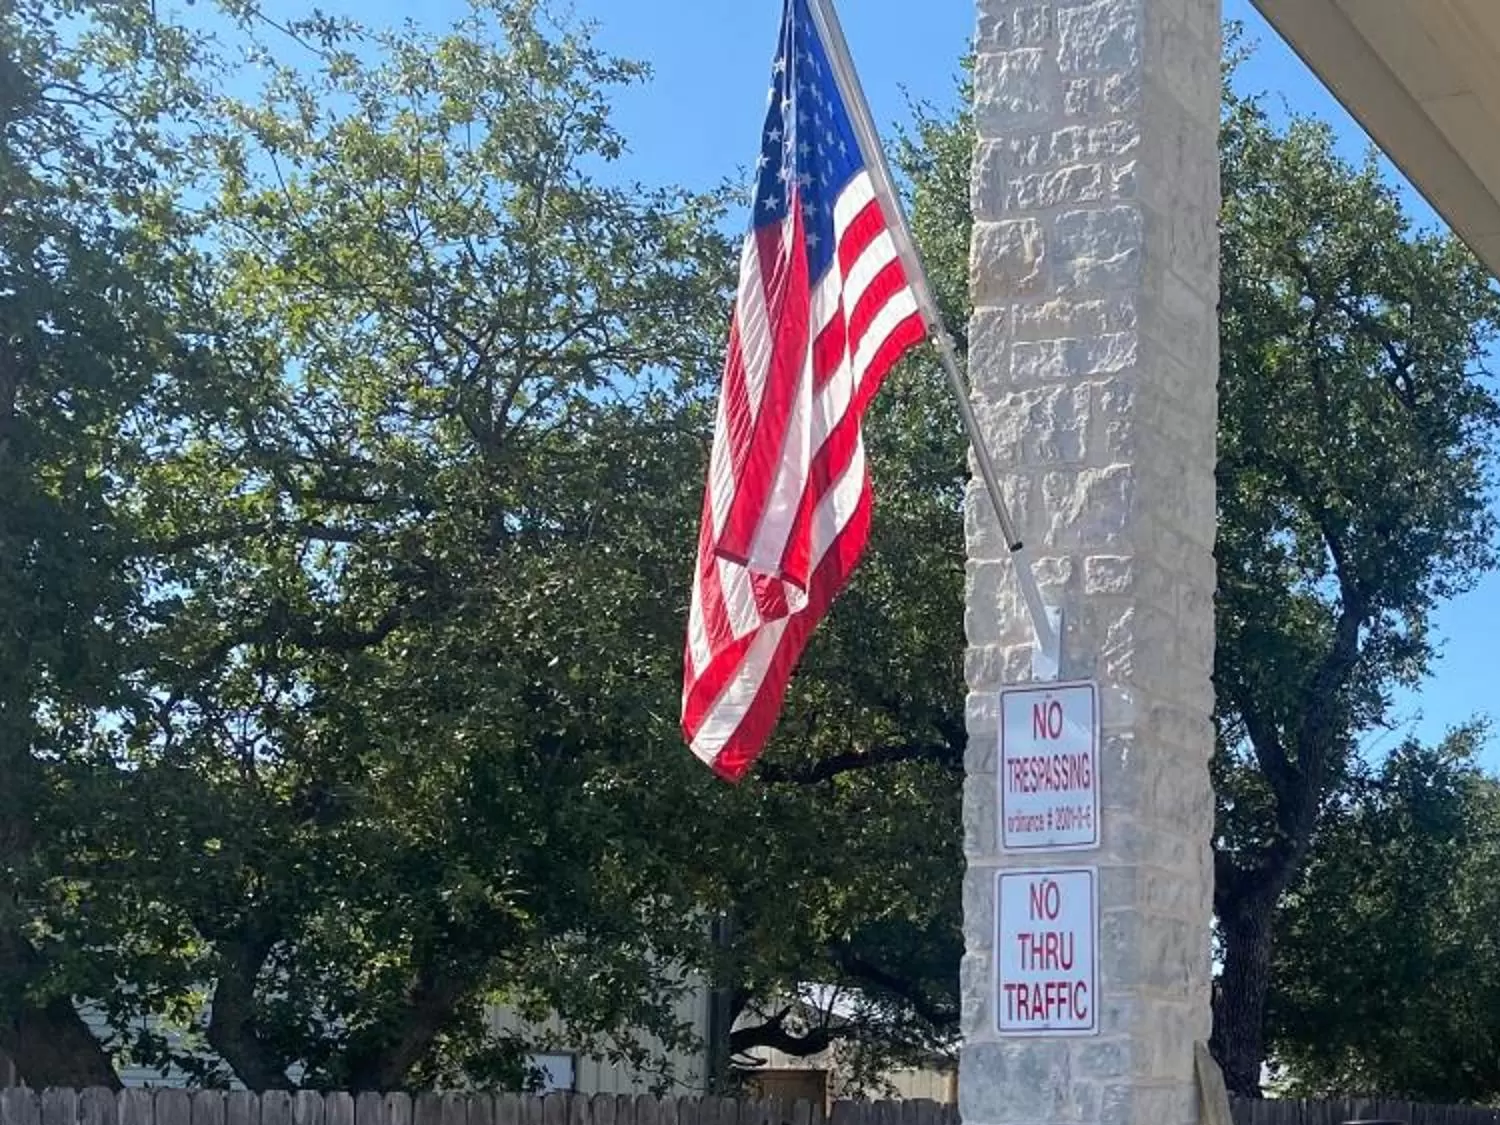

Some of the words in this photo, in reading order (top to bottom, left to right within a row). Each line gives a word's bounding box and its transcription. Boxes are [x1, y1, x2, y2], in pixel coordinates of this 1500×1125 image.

[1033, 700, 1063, 740] NO
[1007, 752, 1091, 793] TRESPASSING
[1029, 880, 1061, 921] NO
[1017, 931, 1074, 971] THRU
[1003, 979, 1088, 1021] TRAFFIC
